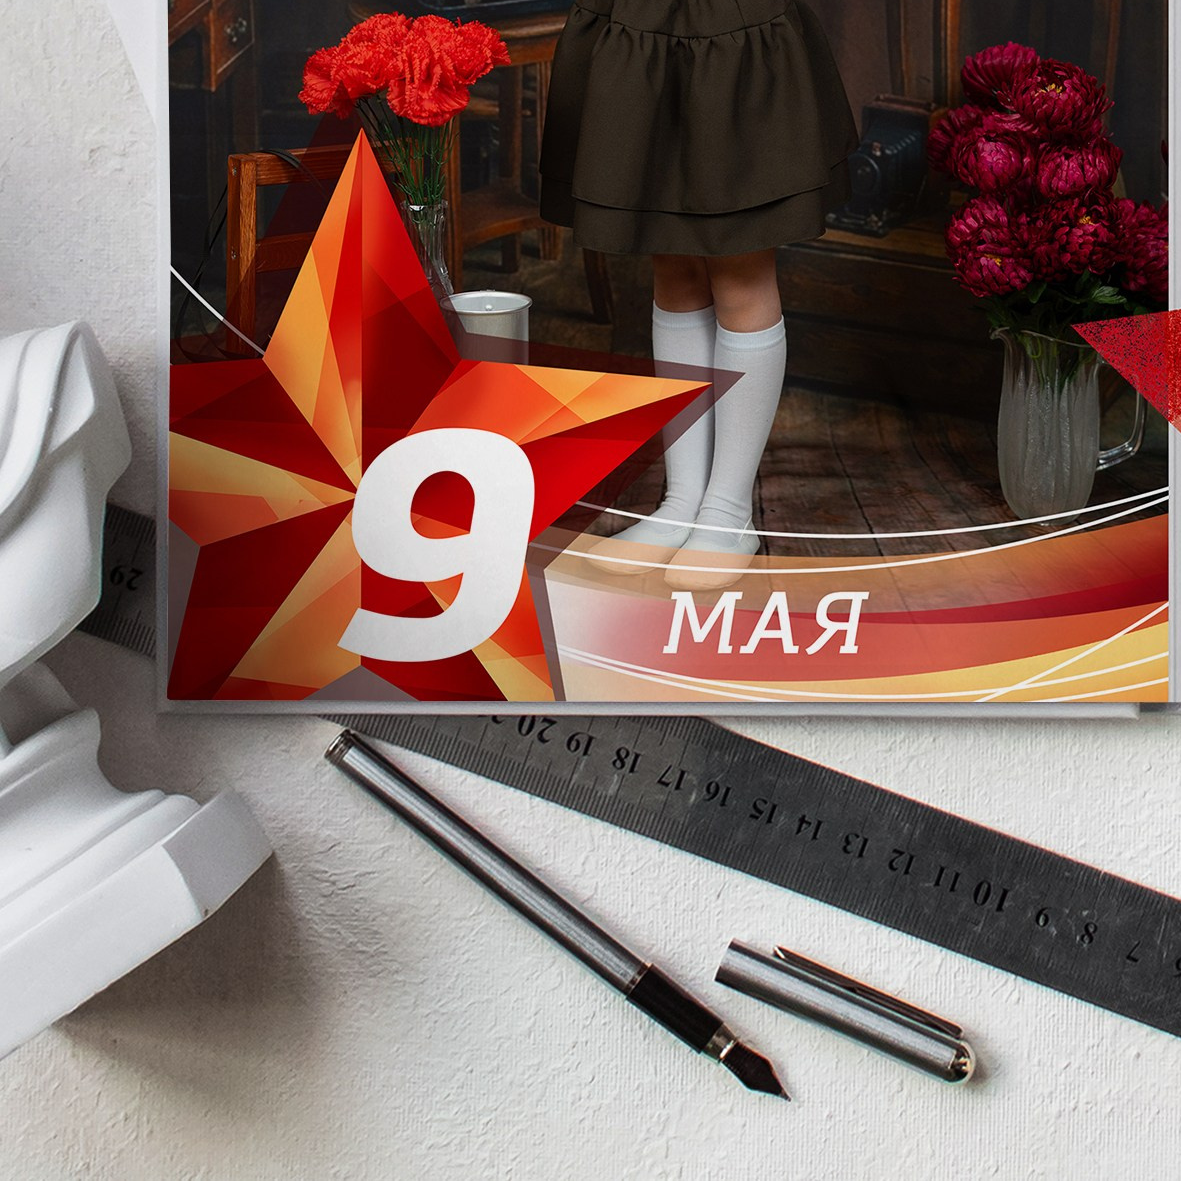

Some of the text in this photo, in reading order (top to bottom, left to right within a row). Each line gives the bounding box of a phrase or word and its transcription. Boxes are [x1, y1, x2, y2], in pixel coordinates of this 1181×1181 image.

[337, 427, 870, 663] 9 МАЯ
[109, 564, 144, 592] 29
[517, 714, 558, 744] 20
[566, 731, 595, 757] 19
[612, 746, 642, 774] 18
[656, 764, 687, 792] 17
[705, 780, 732, 807] 16
[750, 797, 776, 824] 15
[795, 814, 823, 841] 14
[842, 832, 869, 859] 13
[888, 848, 916, 876] 12
[933, 865, 961, 894] 11
[973, 879, 1011, 913] 10
[1034, 906, 1052, 928] 9
[1079, 922, 1098, 945] 8
[1126, 940, 1142, 963] 7
